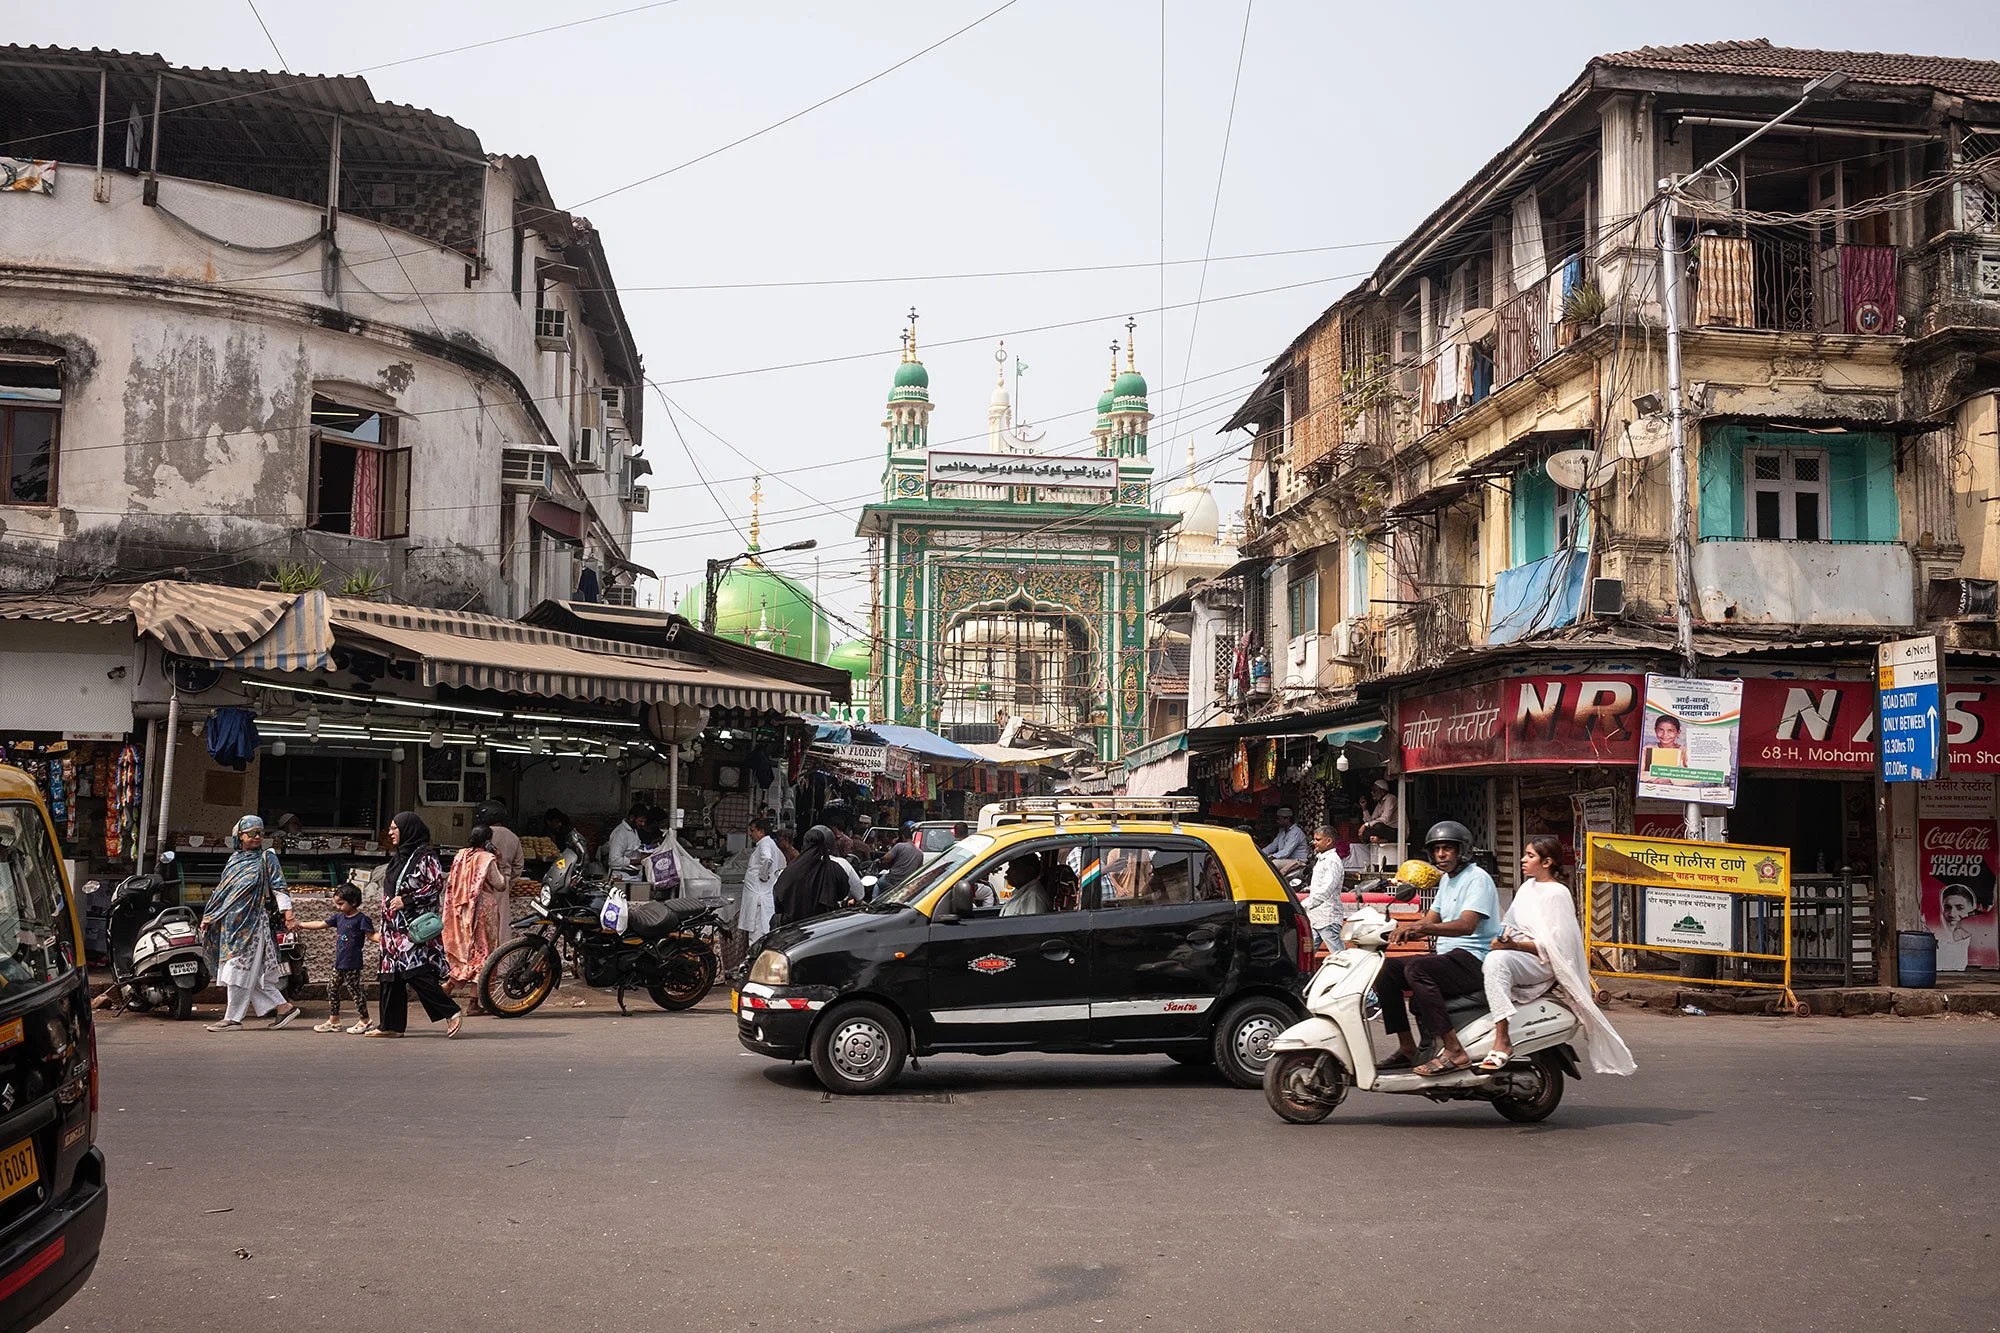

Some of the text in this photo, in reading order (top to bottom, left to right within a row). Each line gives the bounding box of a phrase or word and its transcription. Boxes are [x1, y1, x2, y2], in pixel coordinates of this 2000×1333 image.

[1913, 669, 1936, 680] Mahim
[1883, 692, 1917, 709] ROAD ENTRY
[1403, 709, 1443, 750] नासिर
[1883, 714, 1926, 731] ONLY BETWEEN
[849, 746, 882, 757] FLORIST
[1884, 737, 1915, 753] 13.30hrs TO
[1884, 761, 1908, 776] 07.00hrs
[1924, 826, 1992, 850] Coca-Cola
[1629, 848, 1746, 872] माहिम पोलीस ठाणे
[1930, 854, 1983, 864] KHUD KO
[1929, 864, 1981, 877] JAGAO
[1676, 872, 1695, 881] वाहन
[1722, 875, 1738, 884] नका
[1255, 906, 1275, 914] MH 02
[1163, 1001, 1198, 1012] Santro
